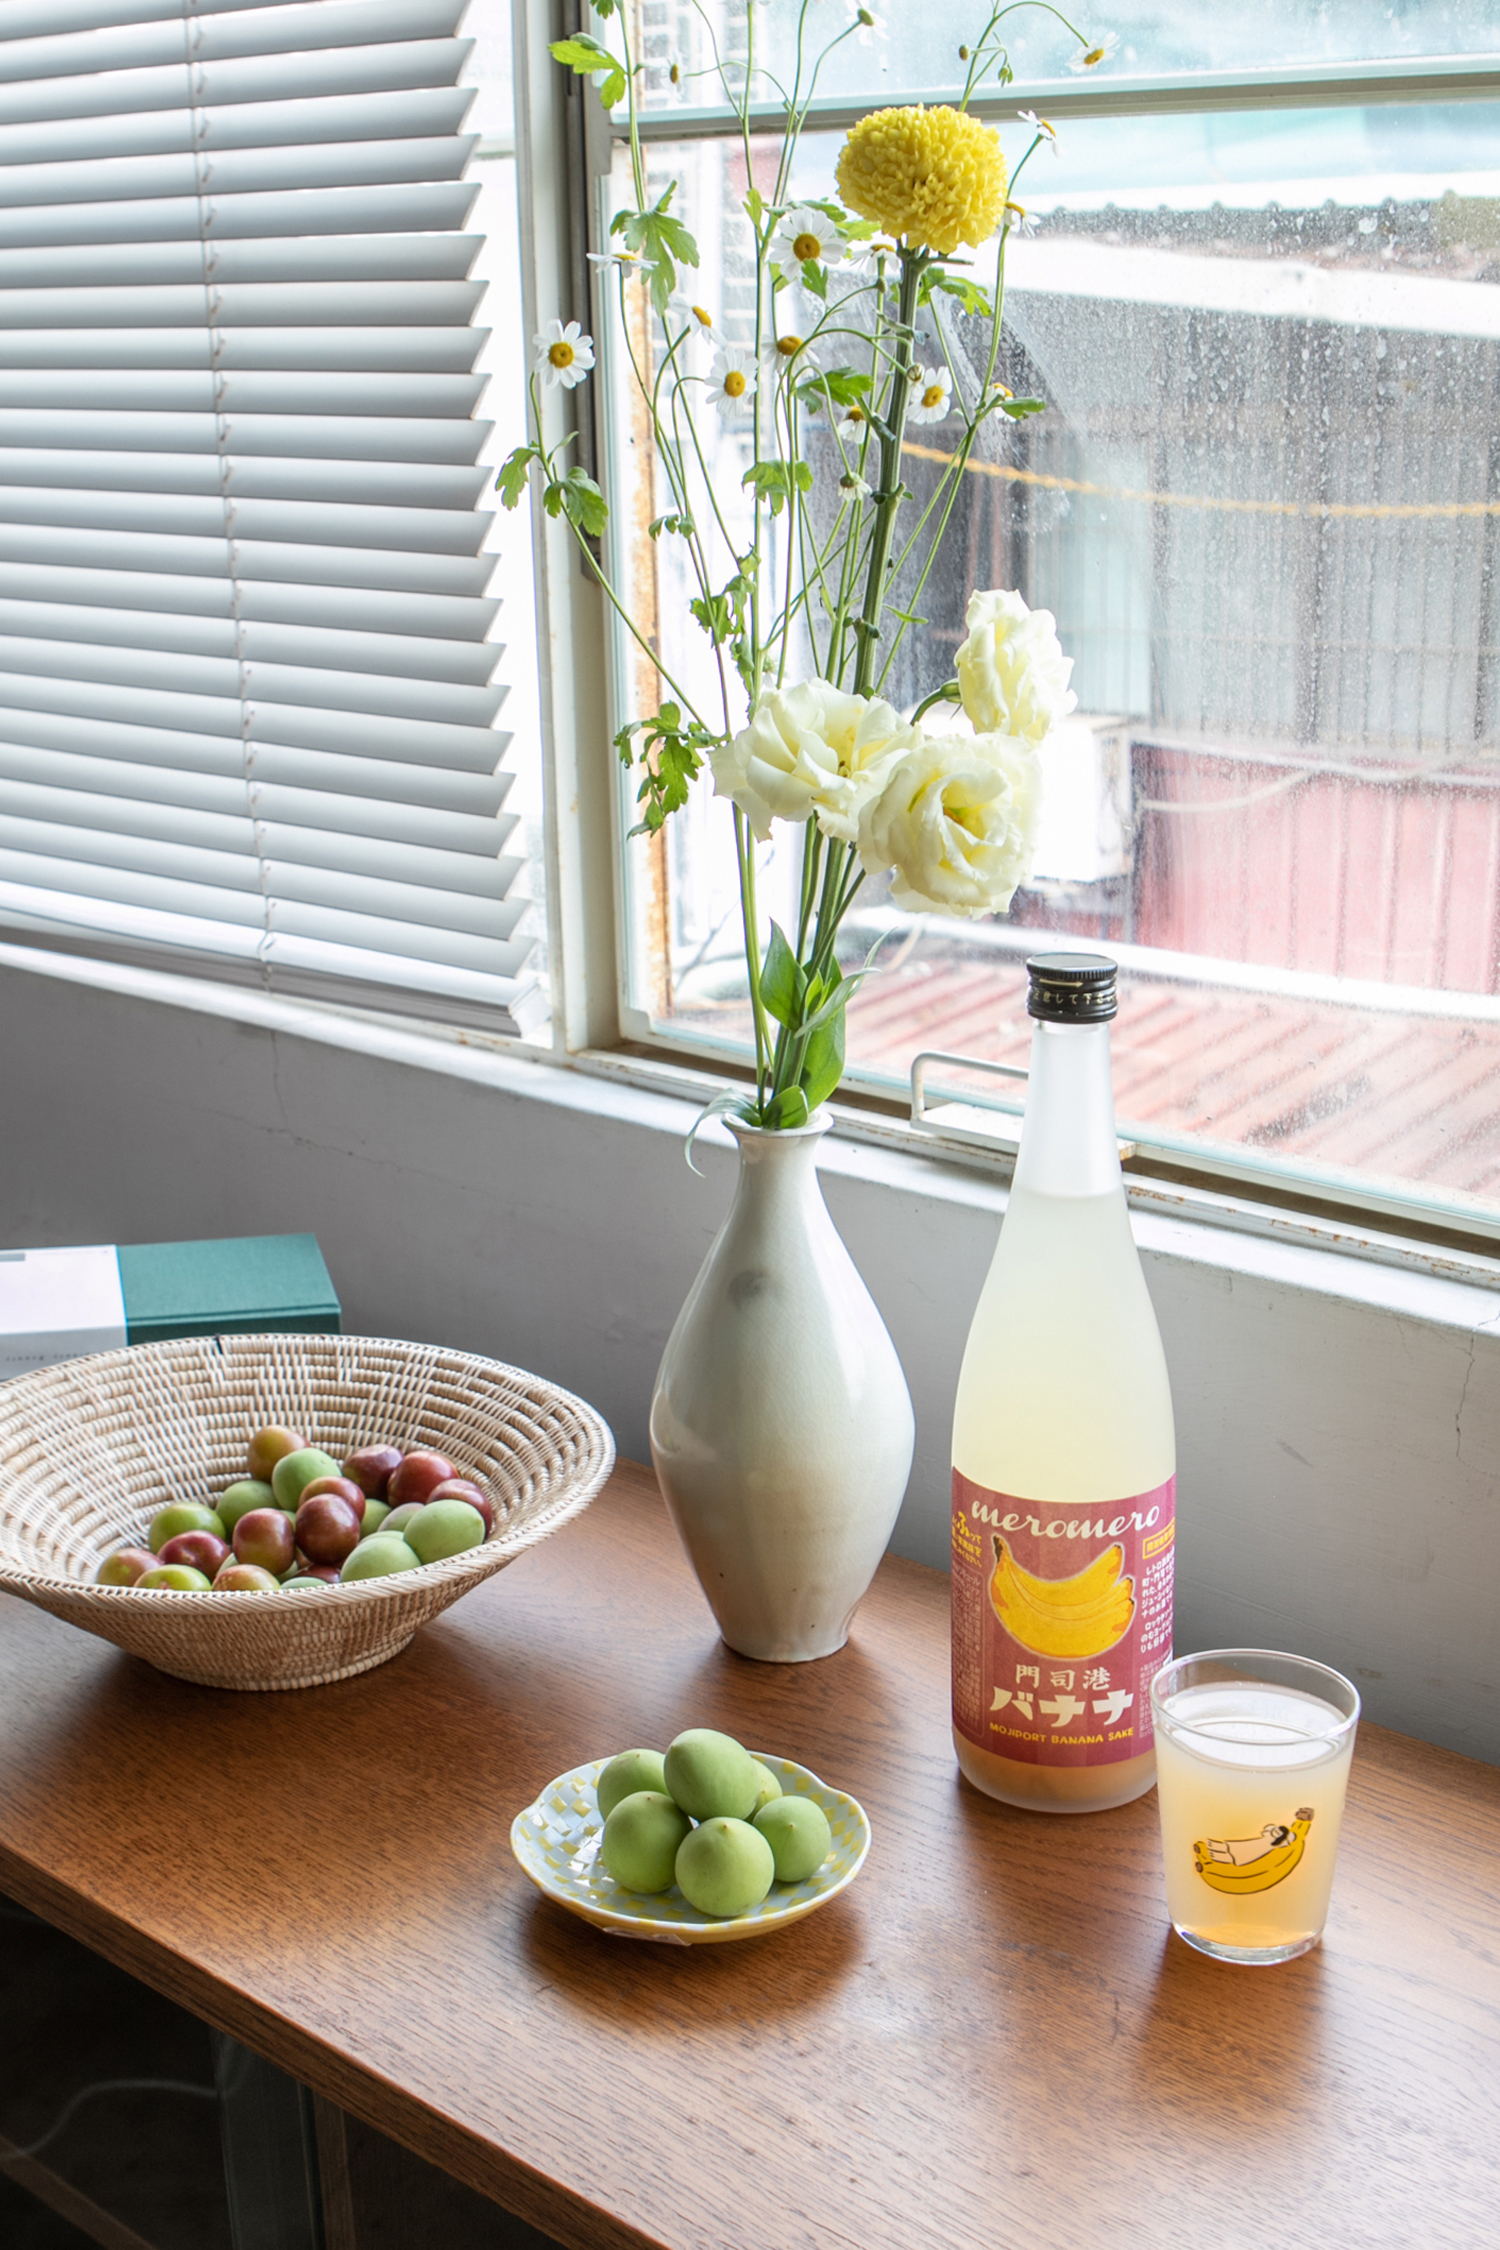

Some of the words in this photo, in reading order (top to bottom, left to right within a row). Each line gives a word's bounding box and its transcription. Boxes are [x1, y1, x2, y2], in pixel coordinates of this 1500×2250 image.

[971, 1500, 1160, 1539] meromero
[1015, 1664, 1111, 1691] 門司港
[989, 1686, 1134, 1727] バナナ
[989, 1722, 1046, 1743] MOJIPORT
[1051, 1734, 1104, 1745] BANANA
[1108, 1727, 1134, 1741] SAKE
